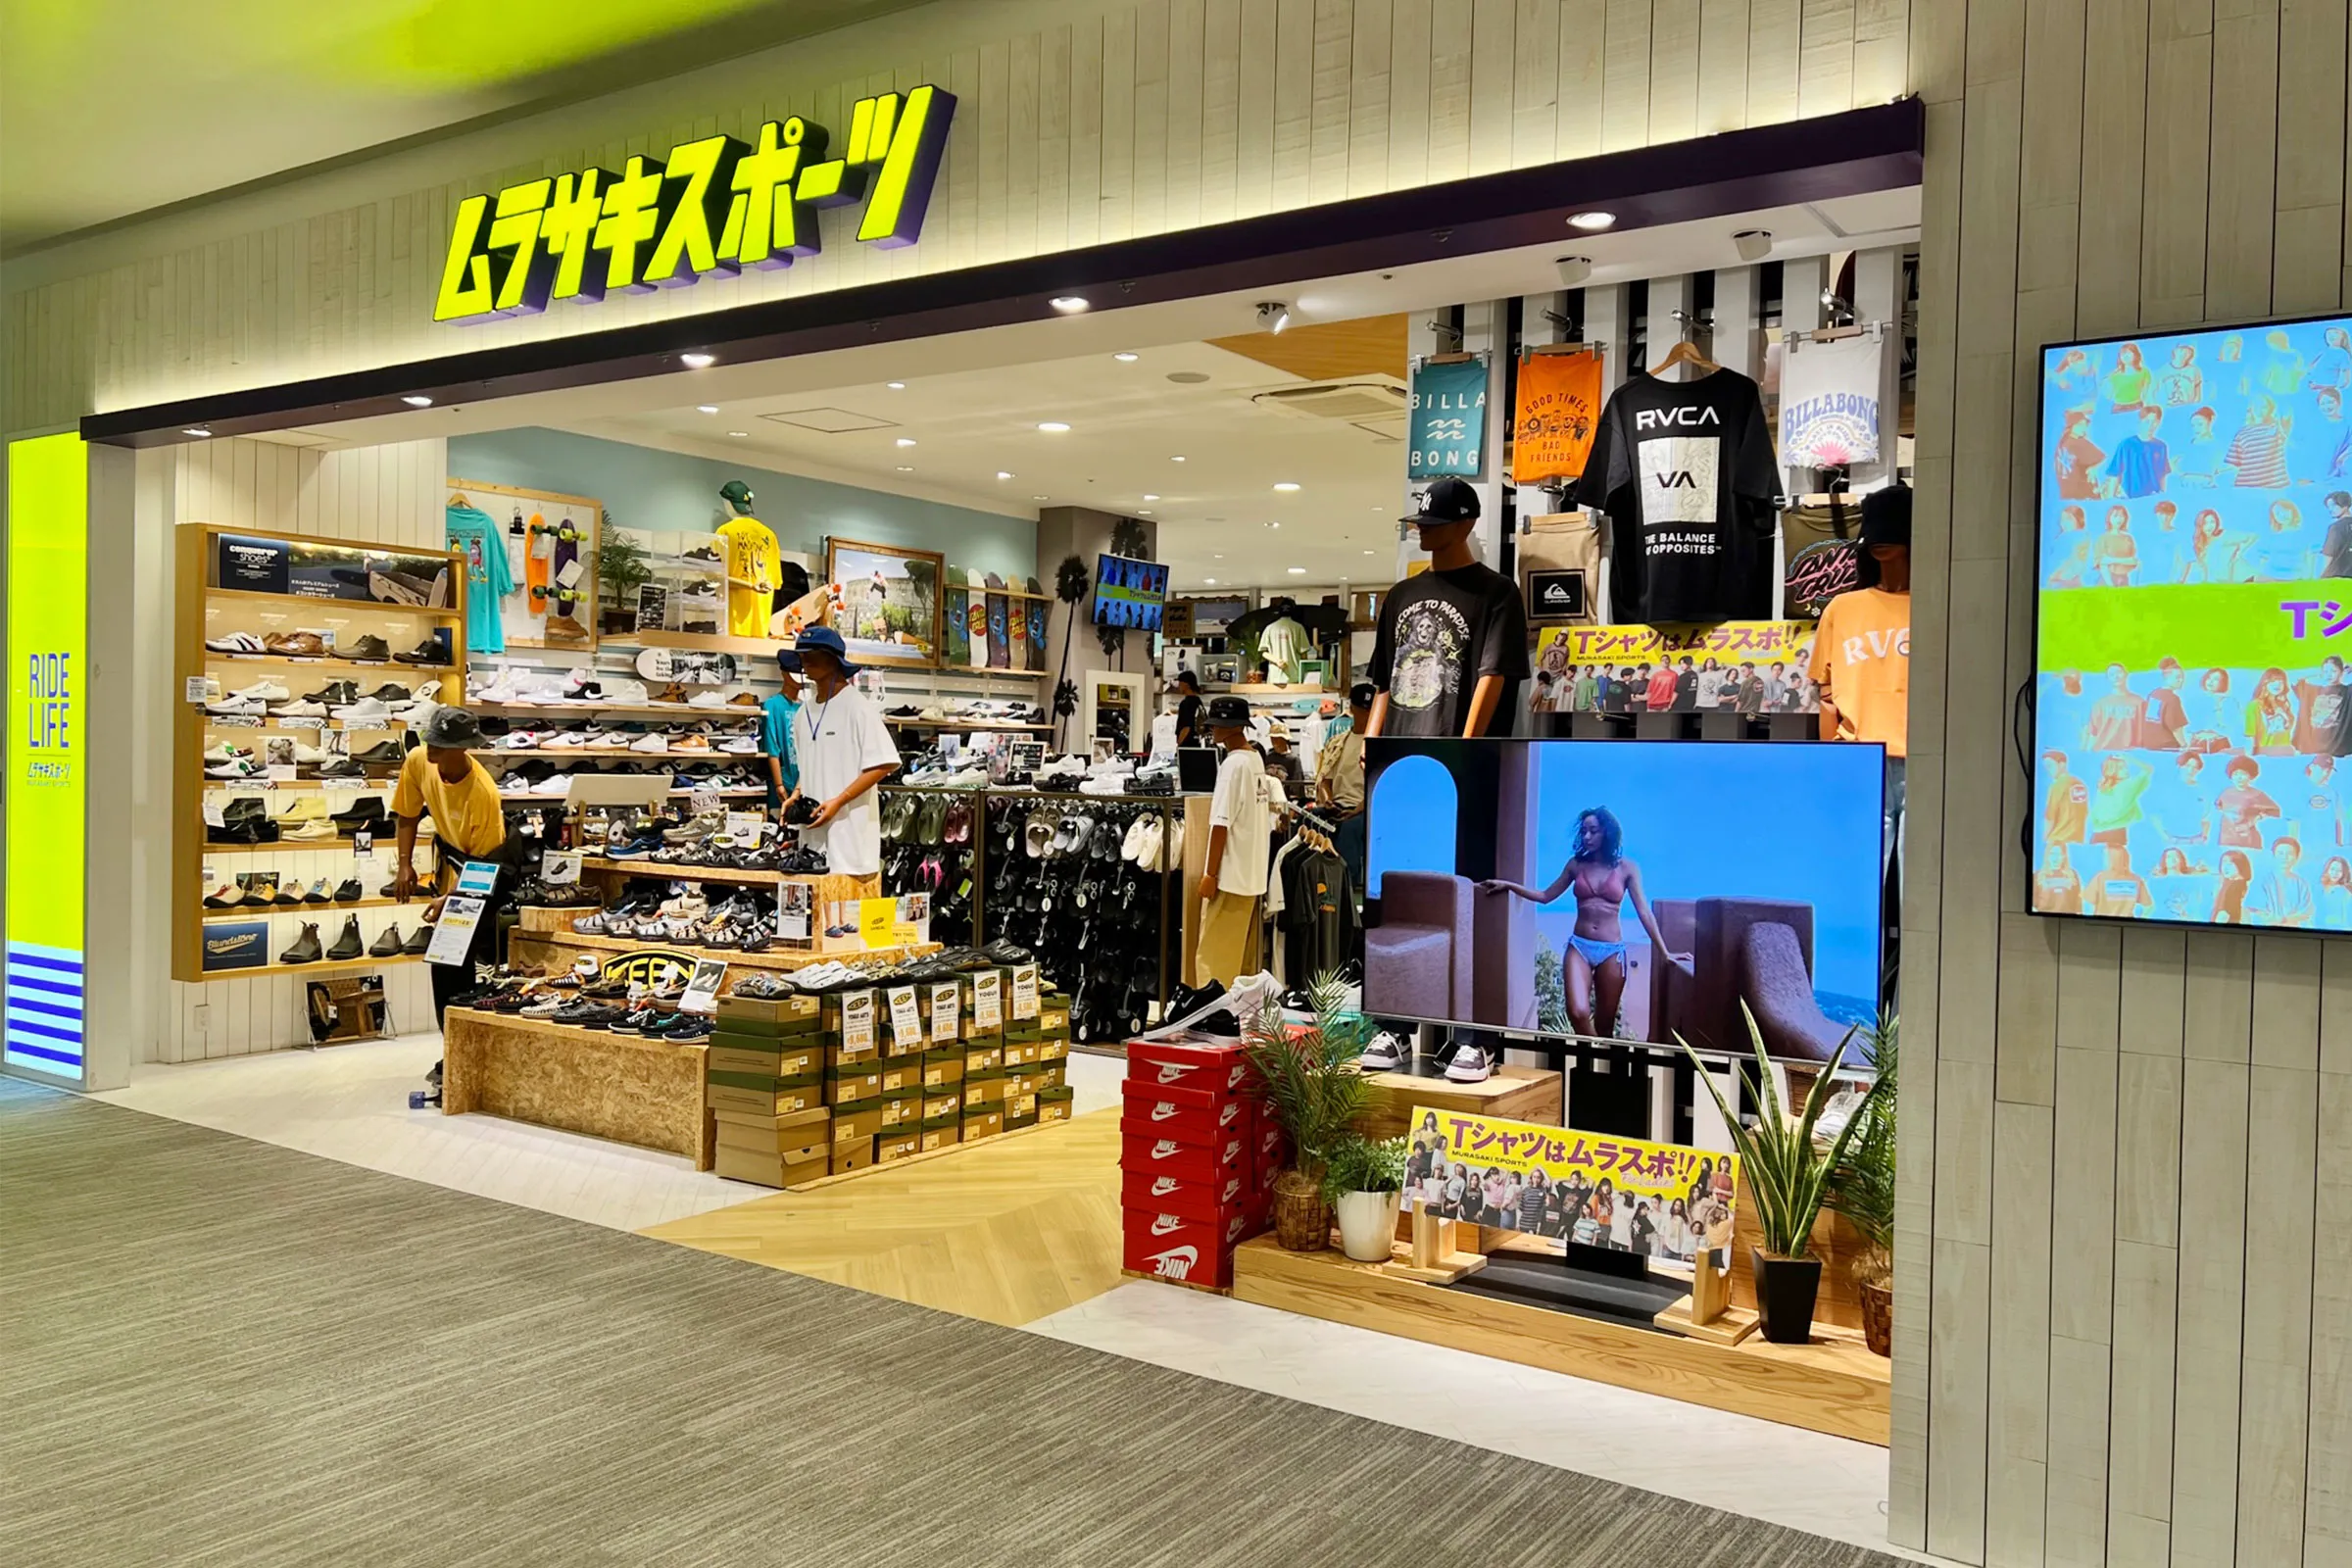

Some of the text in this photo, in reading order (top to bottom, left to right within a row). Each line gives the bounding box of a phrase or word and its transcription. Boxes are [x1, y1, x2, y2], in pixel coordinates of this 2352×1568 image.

[433, 84, 939, 321] ムラサキスポーツ
[1411, 392, 1486, 410] BILLA
[1525, 392, 1589, 414] GOOD TIMES
[1636, 406, 1720, 430] RVCA
[1785, 392, 1879, 444] BILLABONG
[1543, 441, 1560, 450] BAD
[1411, 450, 1478, 466] BONG
[1531, 453, 1571, 463] FRIENDS
[1659, 532, 1715, 543] BALANCE
[1425, 599, 1439, 609] TO
[1439, 601, 1471, 641] PARADISE
[29, 653, 70, 698] RIDE
[29, 703, 70, 748] LIFE
[693, 795, 719, 808] NEW
[1155, 1102, 1175, 1113] NIKE
[1156, 1139, 1176, 1151] NIKE
[1451, 1150, 1528, 1167] MURASAKI SPORTS
[1155, 1176, 1176, 1188] NIKE
[1157, 1213, 1180, 1226] NIKE
[1153, 1257, 1190, 1280] NIKE
